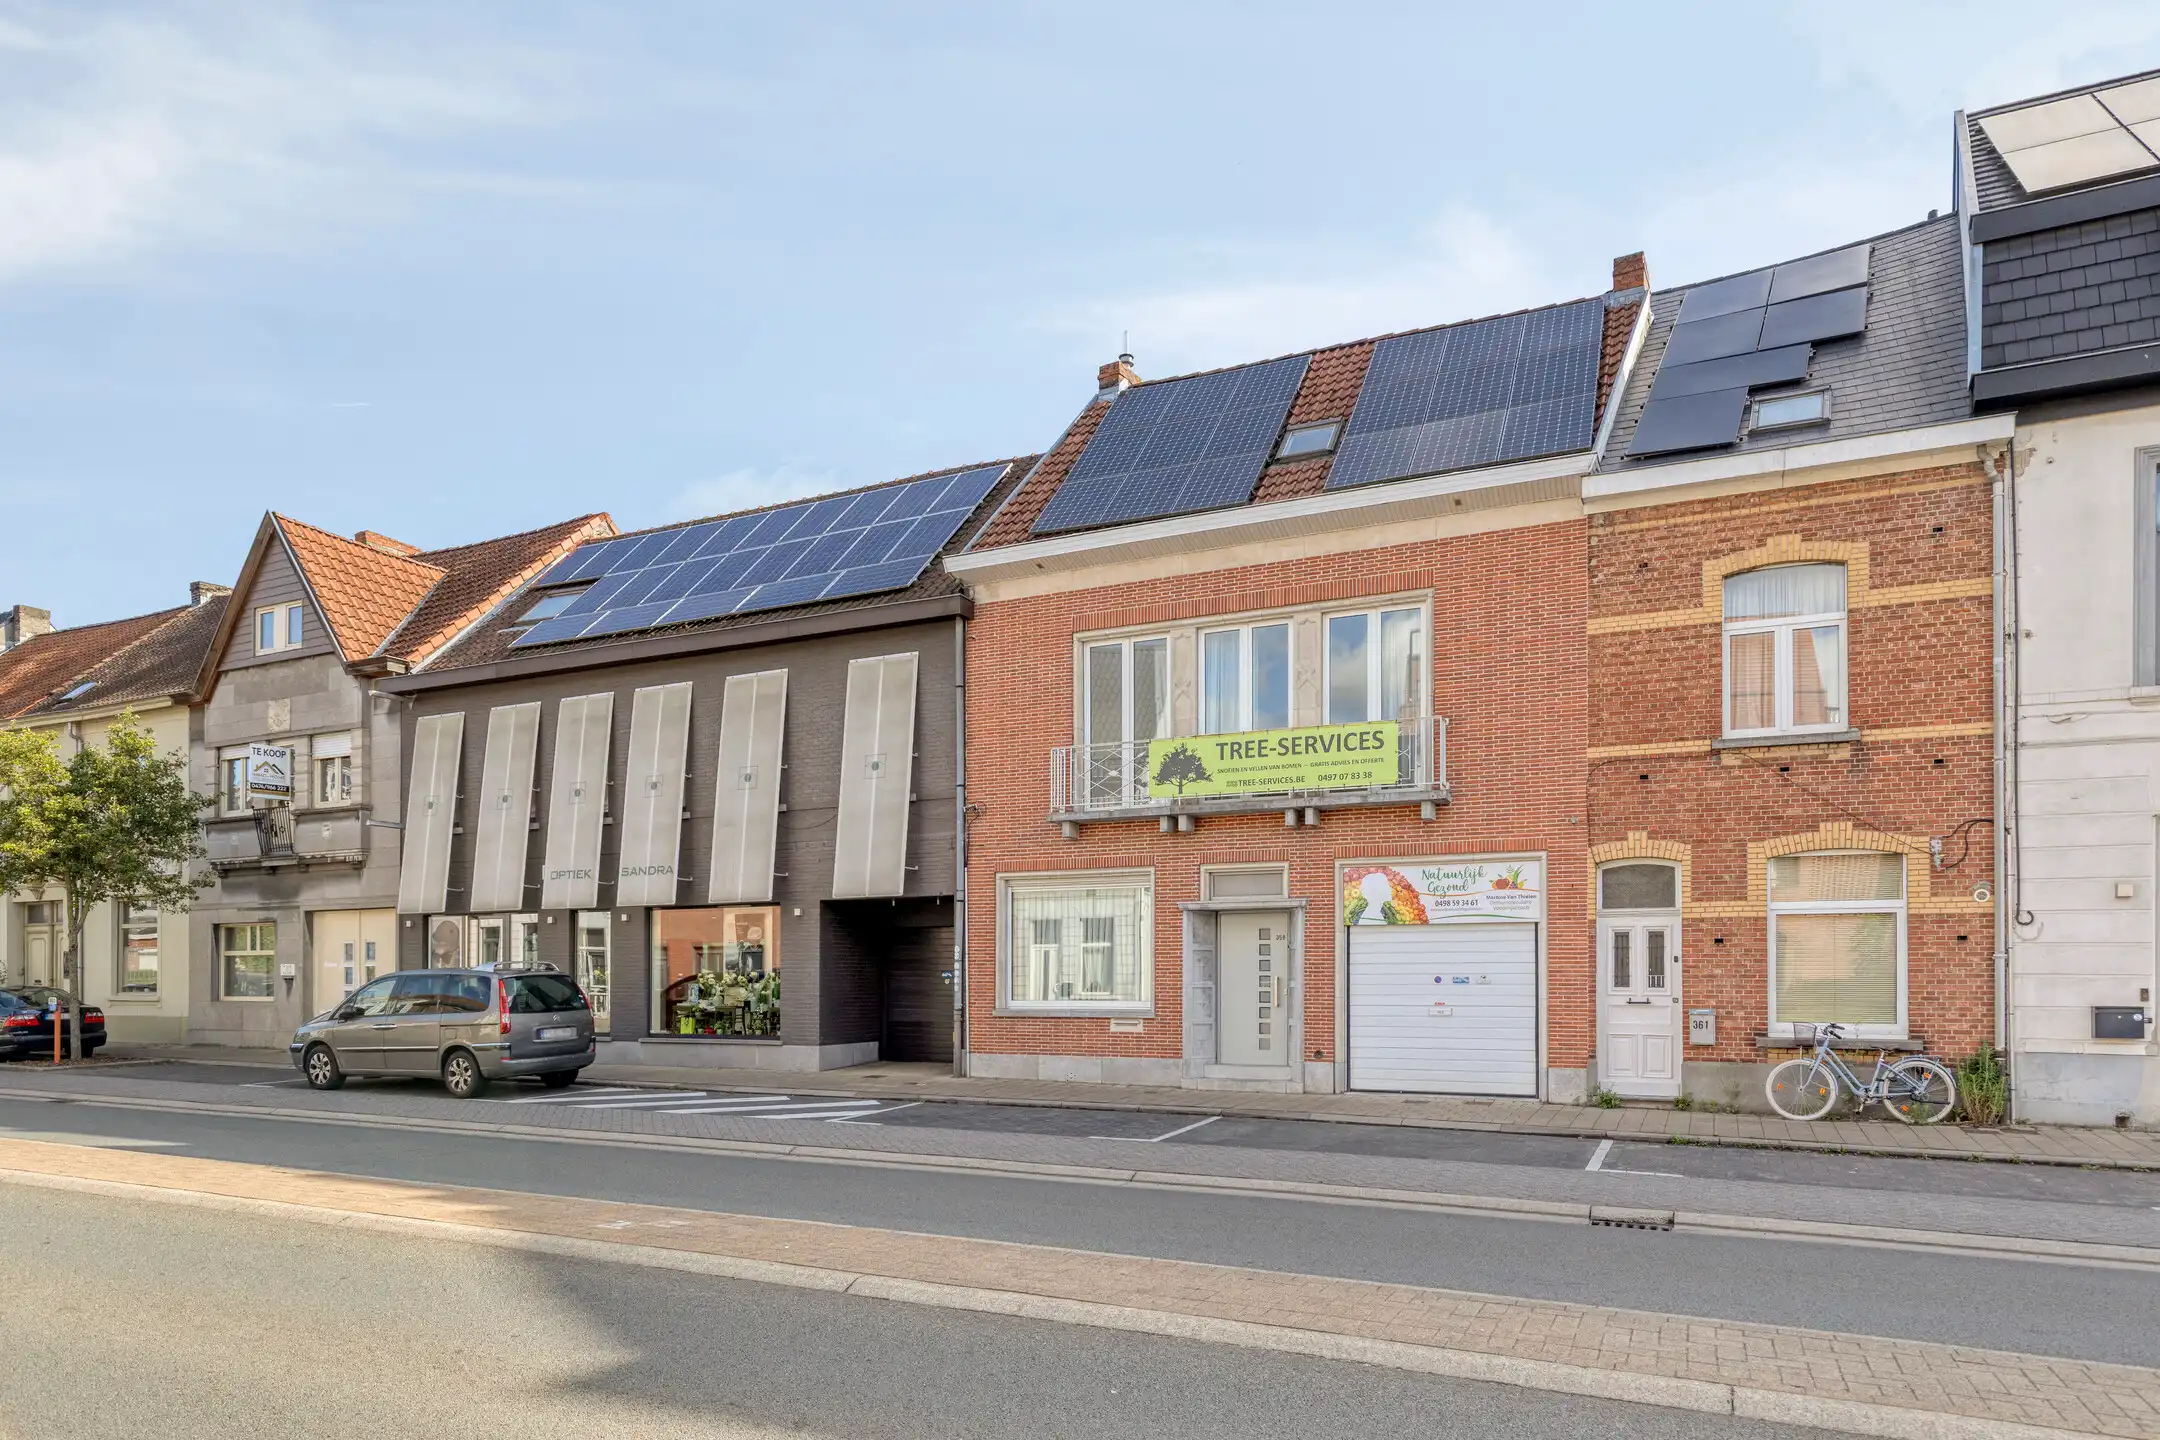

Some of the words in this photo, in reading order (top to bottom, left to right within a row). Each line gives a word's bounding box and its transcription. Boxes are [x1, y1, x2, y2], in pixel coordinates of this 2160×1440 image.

[252, 747, 262, 756] TE
[263, 748, 287, 758] KOOP
[1215, 730, 1385, 761] TREE-SERVICES
[1318, 774, 1337, 782] 0497
[1339, 773, 1349, 781] 07
[1350, 772, 1361, 780] 83
[1362, 771, 1373, 779] 38
[550, 869, 593, 880] OPTIEK
[621, 865, 674, 877] SANDRA
[1421, 865, 1488, 884] Natuurlijk
[1427, 880, 1469, 899] Gezond
[1693, 1020, 1708, 1030] 361
